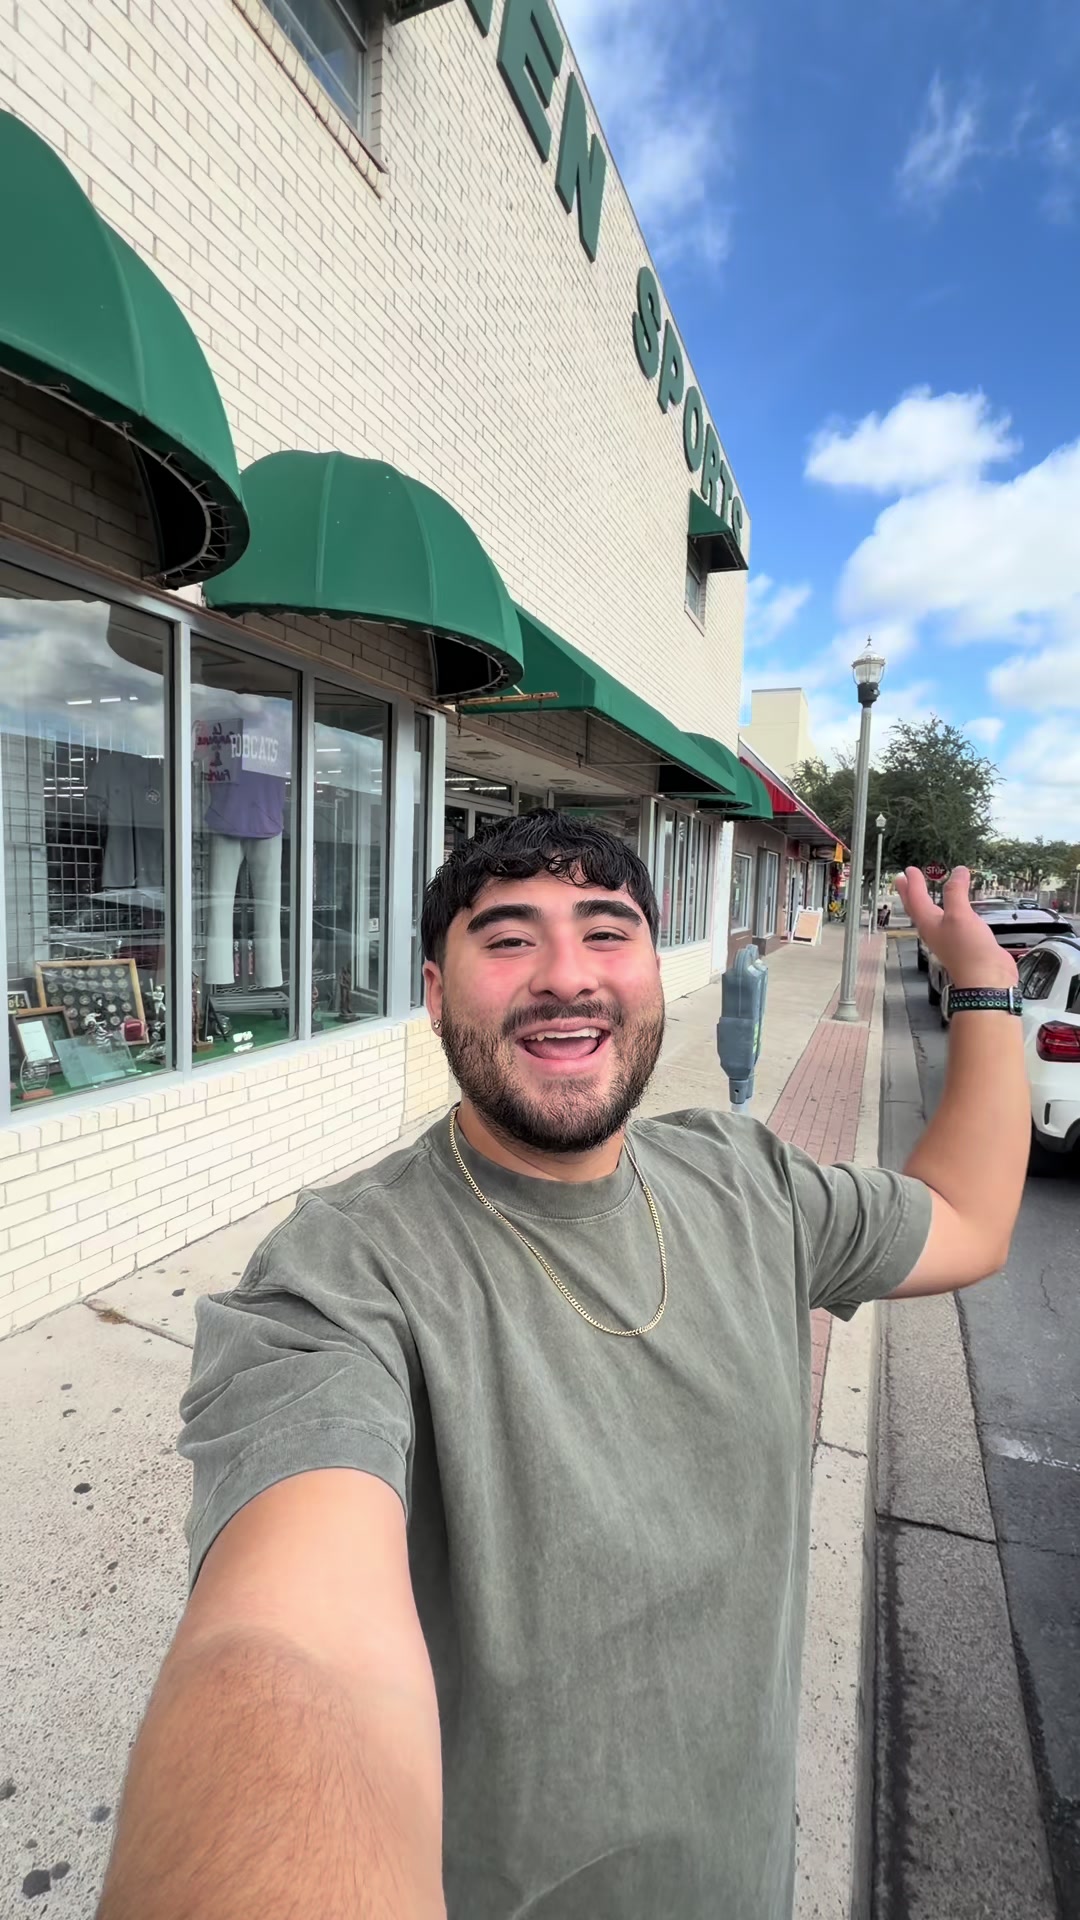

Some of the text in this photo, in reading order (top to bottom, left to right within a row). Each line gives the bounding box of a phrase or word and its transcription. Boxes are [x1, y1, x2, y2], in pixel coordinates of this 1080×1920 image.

[465, 0, 743, 548] EN SPORTS
[926, 866, 946, 875] STOP
